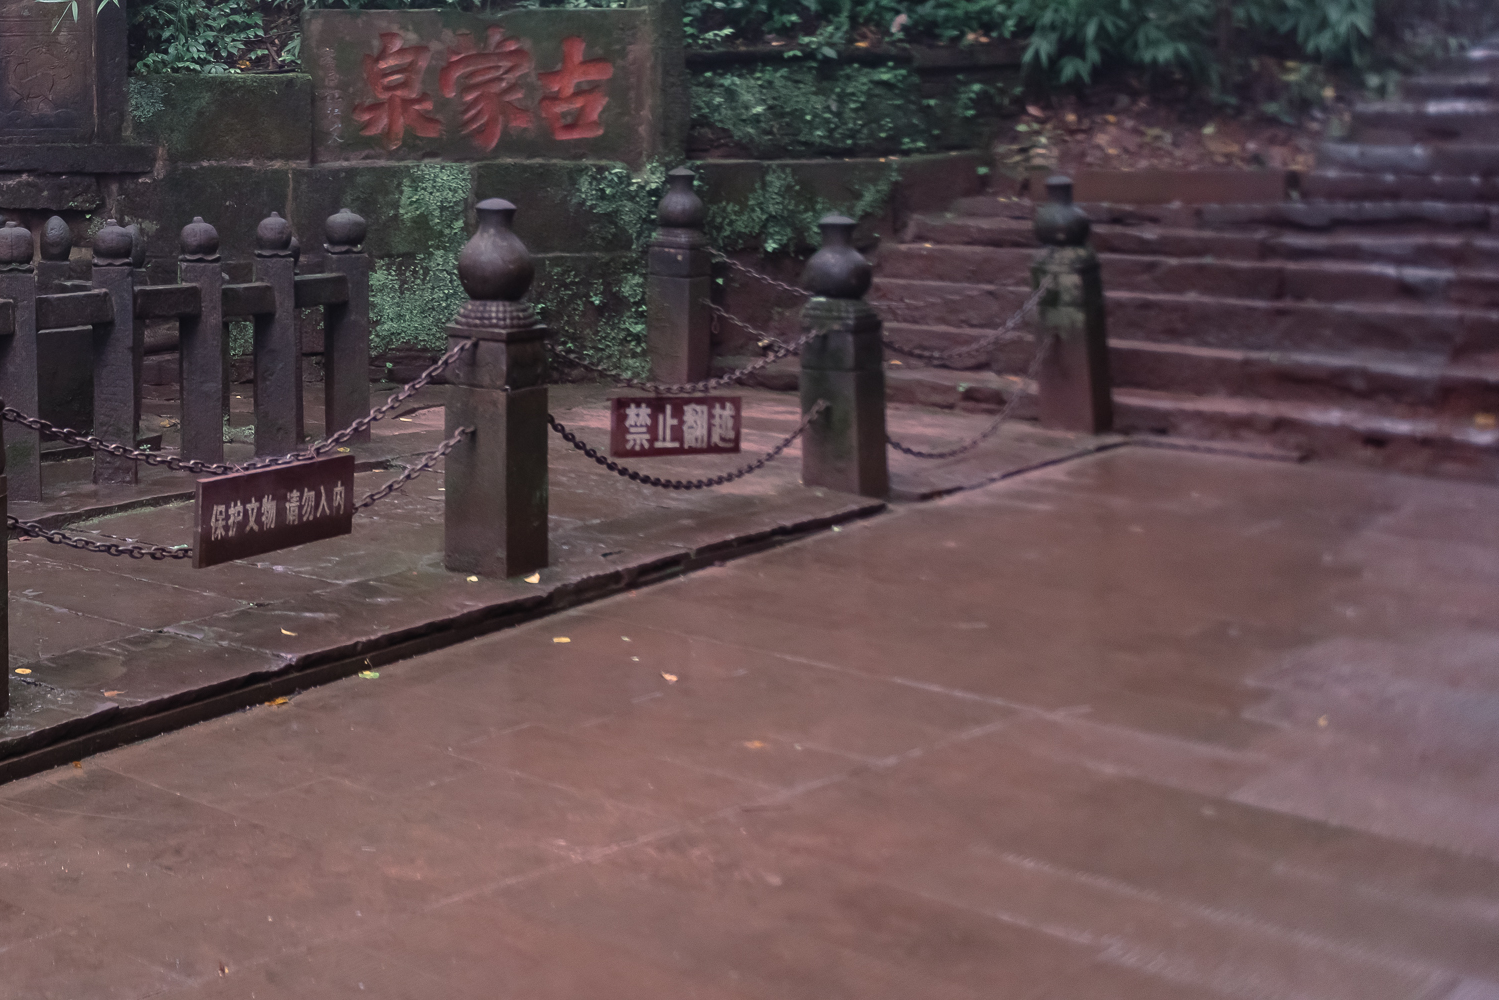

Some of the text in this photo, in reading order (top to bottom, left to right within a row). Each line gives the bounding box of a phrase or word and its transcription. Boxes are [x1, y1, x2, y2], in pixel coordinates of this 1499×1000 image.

[624, 401, 736, 451] 禁止翻越
[210, 480, 345, 541] 保护文物 请勿入内
